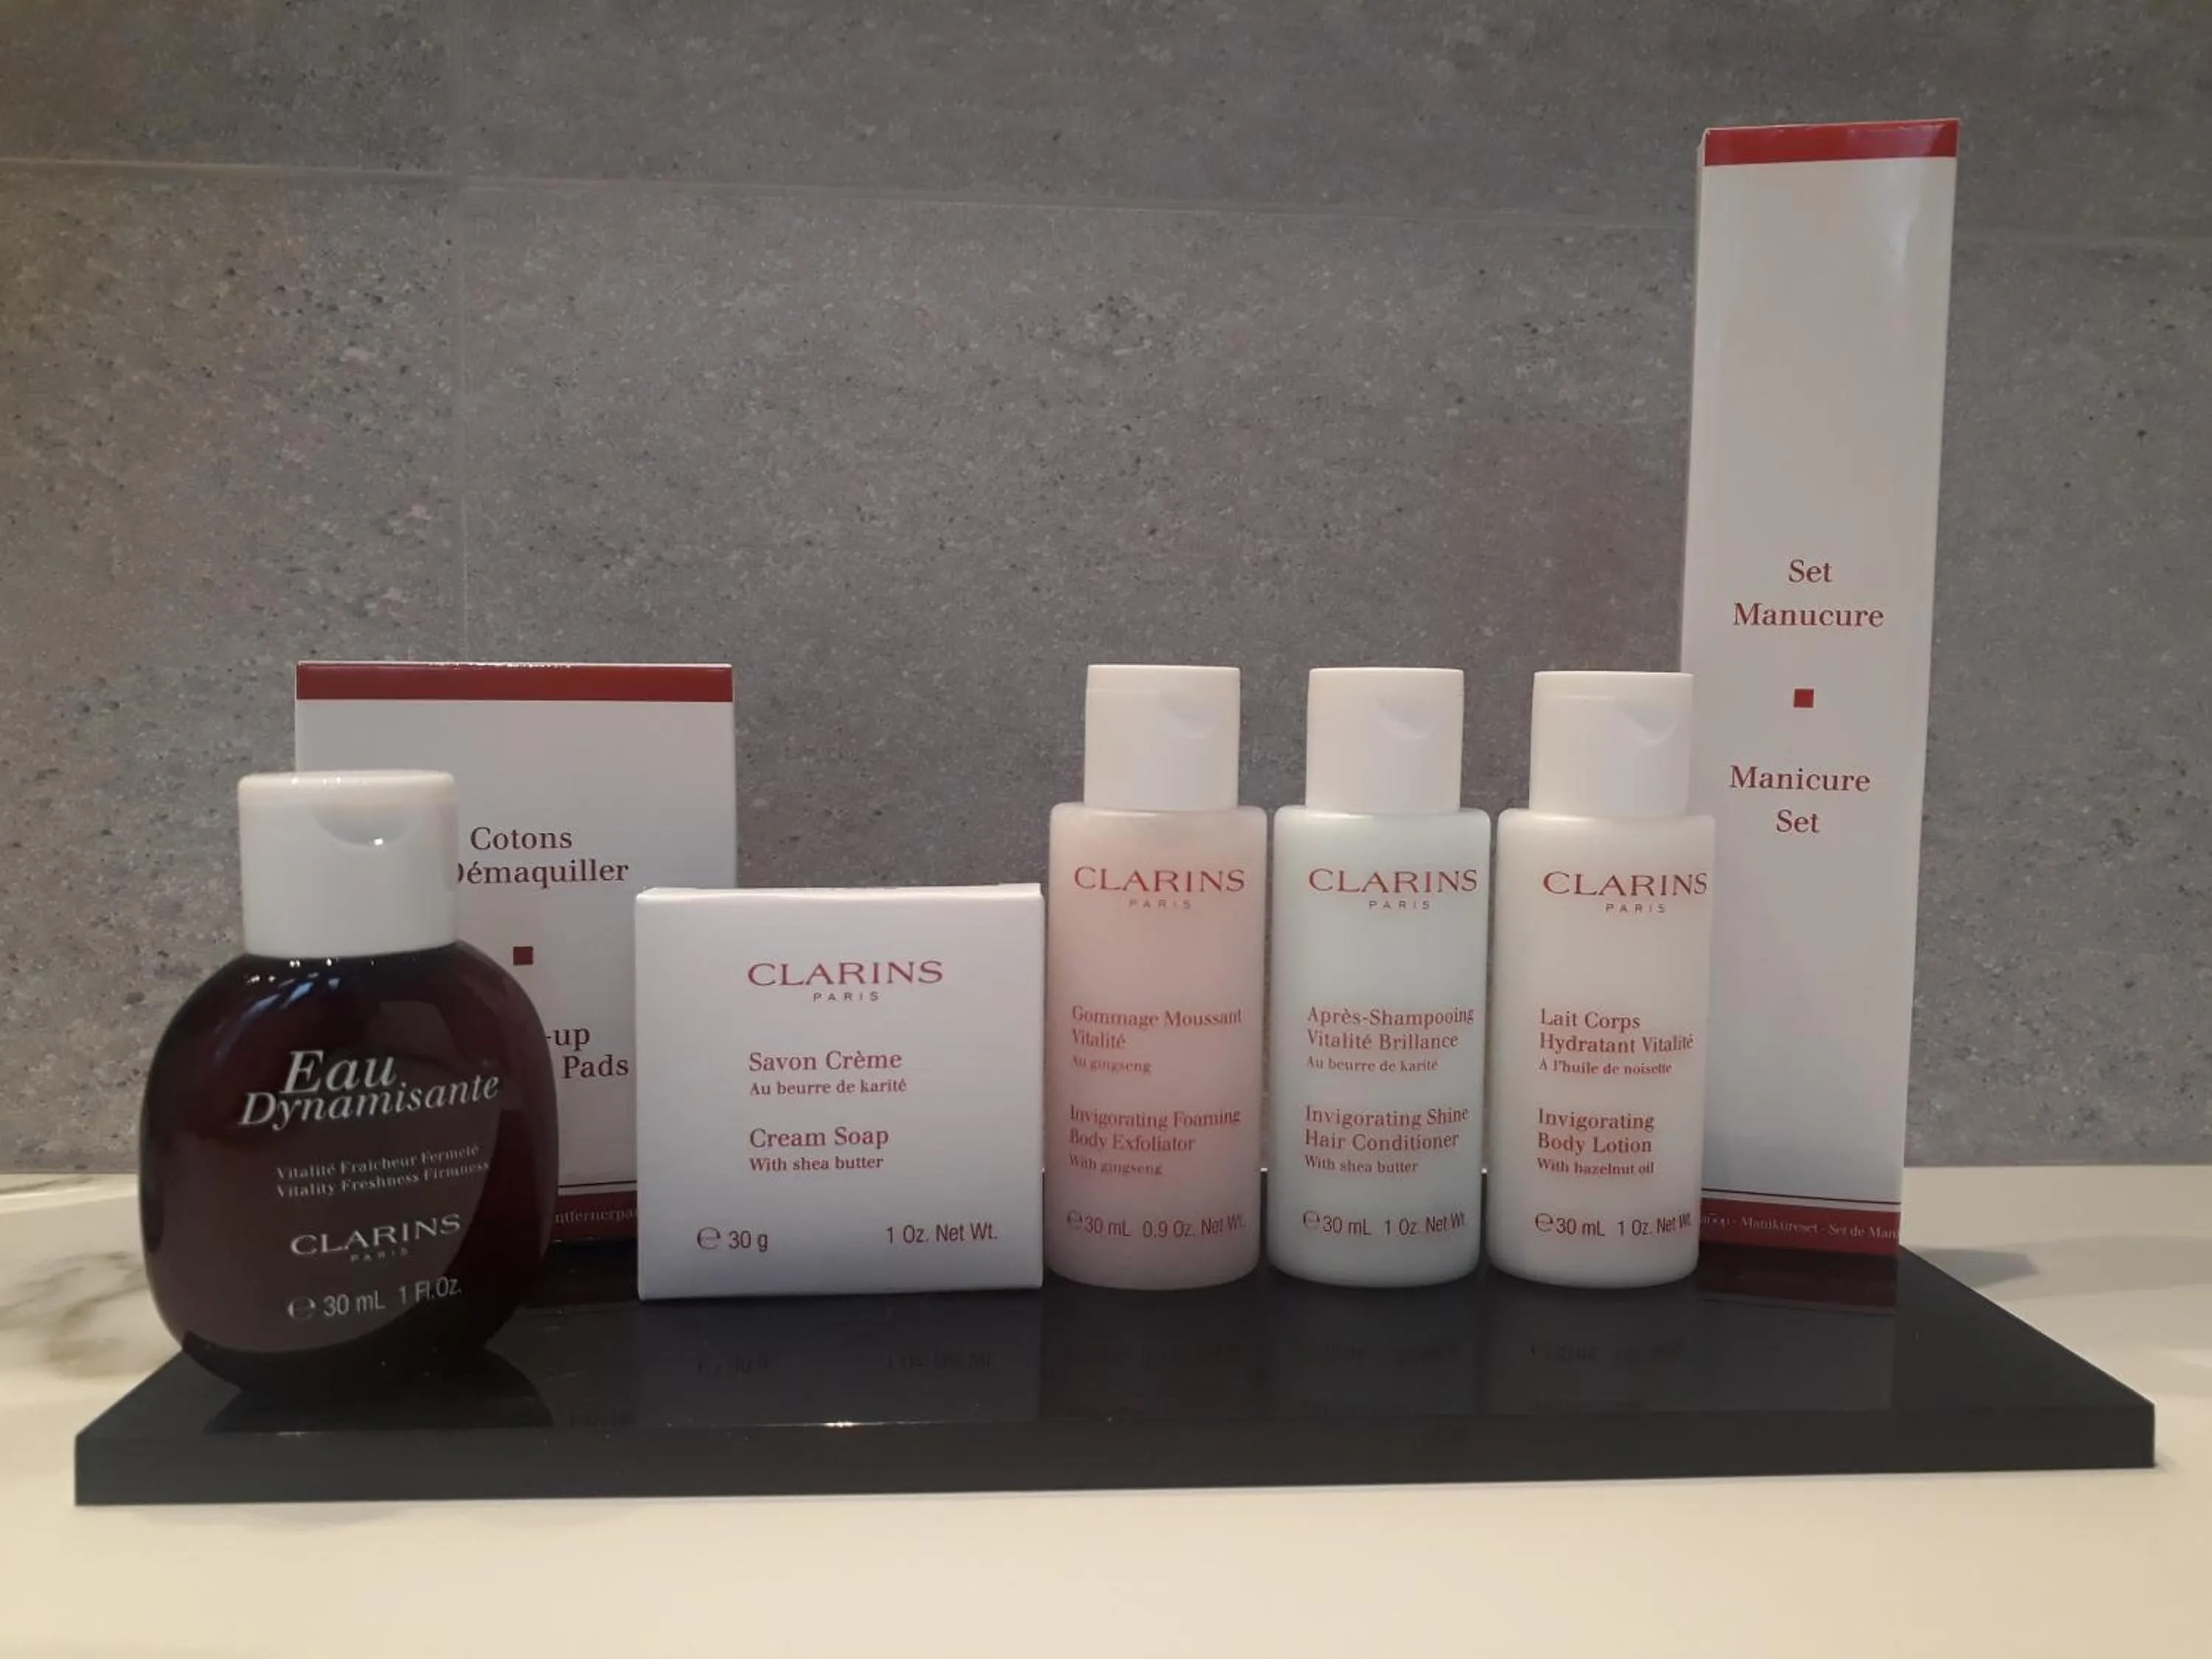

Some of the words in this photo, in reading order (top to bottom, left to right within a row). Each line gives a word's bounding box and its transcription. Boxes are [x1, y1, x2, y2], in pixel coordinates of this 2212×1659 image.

[1788, 559, 1833, 583] Set
[1733, 602, 1885, 627] Manucure
[1729, 765, 1871, 792] Manicure
[1776, 810, 1820, 833] Set
[470, 826, 573, 850] Cotons
[1074, 866, 1245, 893] CLARINS
[1309, 867, 1478, 894] CLARINS
[1543, 871, 1708, 897] CLARINS
[1129, 899, 1192, 909] PARIS
[1369, 900, 1430, 910] PARIS
[1605, 903, 1666, 914] PARIS
[748, 961, 943, 987] CLARINS
[813, 991, 879, 1002] PARIS
[1072, 1005, 1160, 1030] Gommage
[1164, 1009, 1242, 1028] Moussant
[1307, 1006, 1474, 1030] Après-Shampooing
[1540, 1008, 1578, 1027] Lait
[1585, 1011, 1641, 1034] Corps
[546, 1028, 591, 1051] -up
[1072, 1028, 1127, 1050] Vitalité
[1307, 1028, 1372, 1050] Vitalité
[1380, 1033, 1458, 1051] Brillance
[1540, 1032, 1636, 1054] Hydratant
[1642, 1032, 1694, 1052] Vitalité
[563, 1053, 630, 1079] Pads
[749, 1051, 817, 1071] Savon
[825, 1048, 902, 1070] Crème
[1307, 1055, 1324, 1069] Au
[1328, 1057, 1375, 1072] beurre
[1380, 1060, 1397, 1072] de
[1603, 1062, 1620, 1074] de
[279, 1050, 397, 1093] Eau
[750, 1082, 771, 1095] Au
[776, 1081, 831, 1095] beurre
[836, 1080, 855, 1093] de
[860, 1078, 907, 1093] karité
[237, 1074, 500, 1131] Dynamisante
[1070, 1104, 1169, 1130] Invigorating
[1174, 1109, 1241, 1128] Foaming
[1305, 1105, 1422, 1130] Invigorating
[1427, 1106, 1470, 1125] Shine
[1538, 1107, 1655, 1133] Invigorating
[750, 1128, 827, 1148] Cream
[834, 1126, 889, 1150] Soap
[1070, 1127, 1107, 1150] Body
[1113, 1134, 1197, 1152] Exfoliator
[1305, 1129, 1346, 1150] Hair
[1352, 1133, 1459, 1152] Conditioner
[1538, 1131, 1586, 1155] Body
[1592, 1136, 1652, 1154] Lotion
[750, 1157, 787, 1171] With
[793, 1156, 830, 1171] shea
[835, 1155, 885, 1170] butter
[1069, 1155, 1096, 1170] With
[1304, 1155, 1335, 1170] With
[1339, 1159, 1373, 1174] shea
[1377, 1161, 1419, 1174] butter
[1537, 1157, 1570, 1174] With
[1574, 1161, 1635, 1175] hazelnut
[1638, 1161, 1655, 1175] oil
[276, 1182, 335, 1198] Vitality
[290, 1214, 461, 1255] CLARINS
[902, 1225, 928, 1244] Oz.
[935, 1223, 964, 1242] Net
[970, 1222, 998, 1239] Wt.
[1085, 1217, 1104, 1234] 30
[1107, 1221, 1130, 1237] mL
[1143, 1220, 1169, 1238] 0.9
[1201, 1217, 1223, 1235] Net
[1322, 1215, 1343, 1234] 30
[1347, 1219, 1371, 1235] mL
[1425, 1216, 1447, 1234] Net
[1556, 1217, 1576, 1234] 30
[1582, 1220, 1605, 1237] mL
[1632, 1219, 1652, 1236] Oz.
[1656, 1217, 1676, 1234] Net
[728, 1230, 751, 1249] 30
[757, 1235, 768, 1252] g
[323, 1293, 349, 1317] 30
[356, 1290, 385, 1314] mL
[398, 1286, 406, 1304] 1
